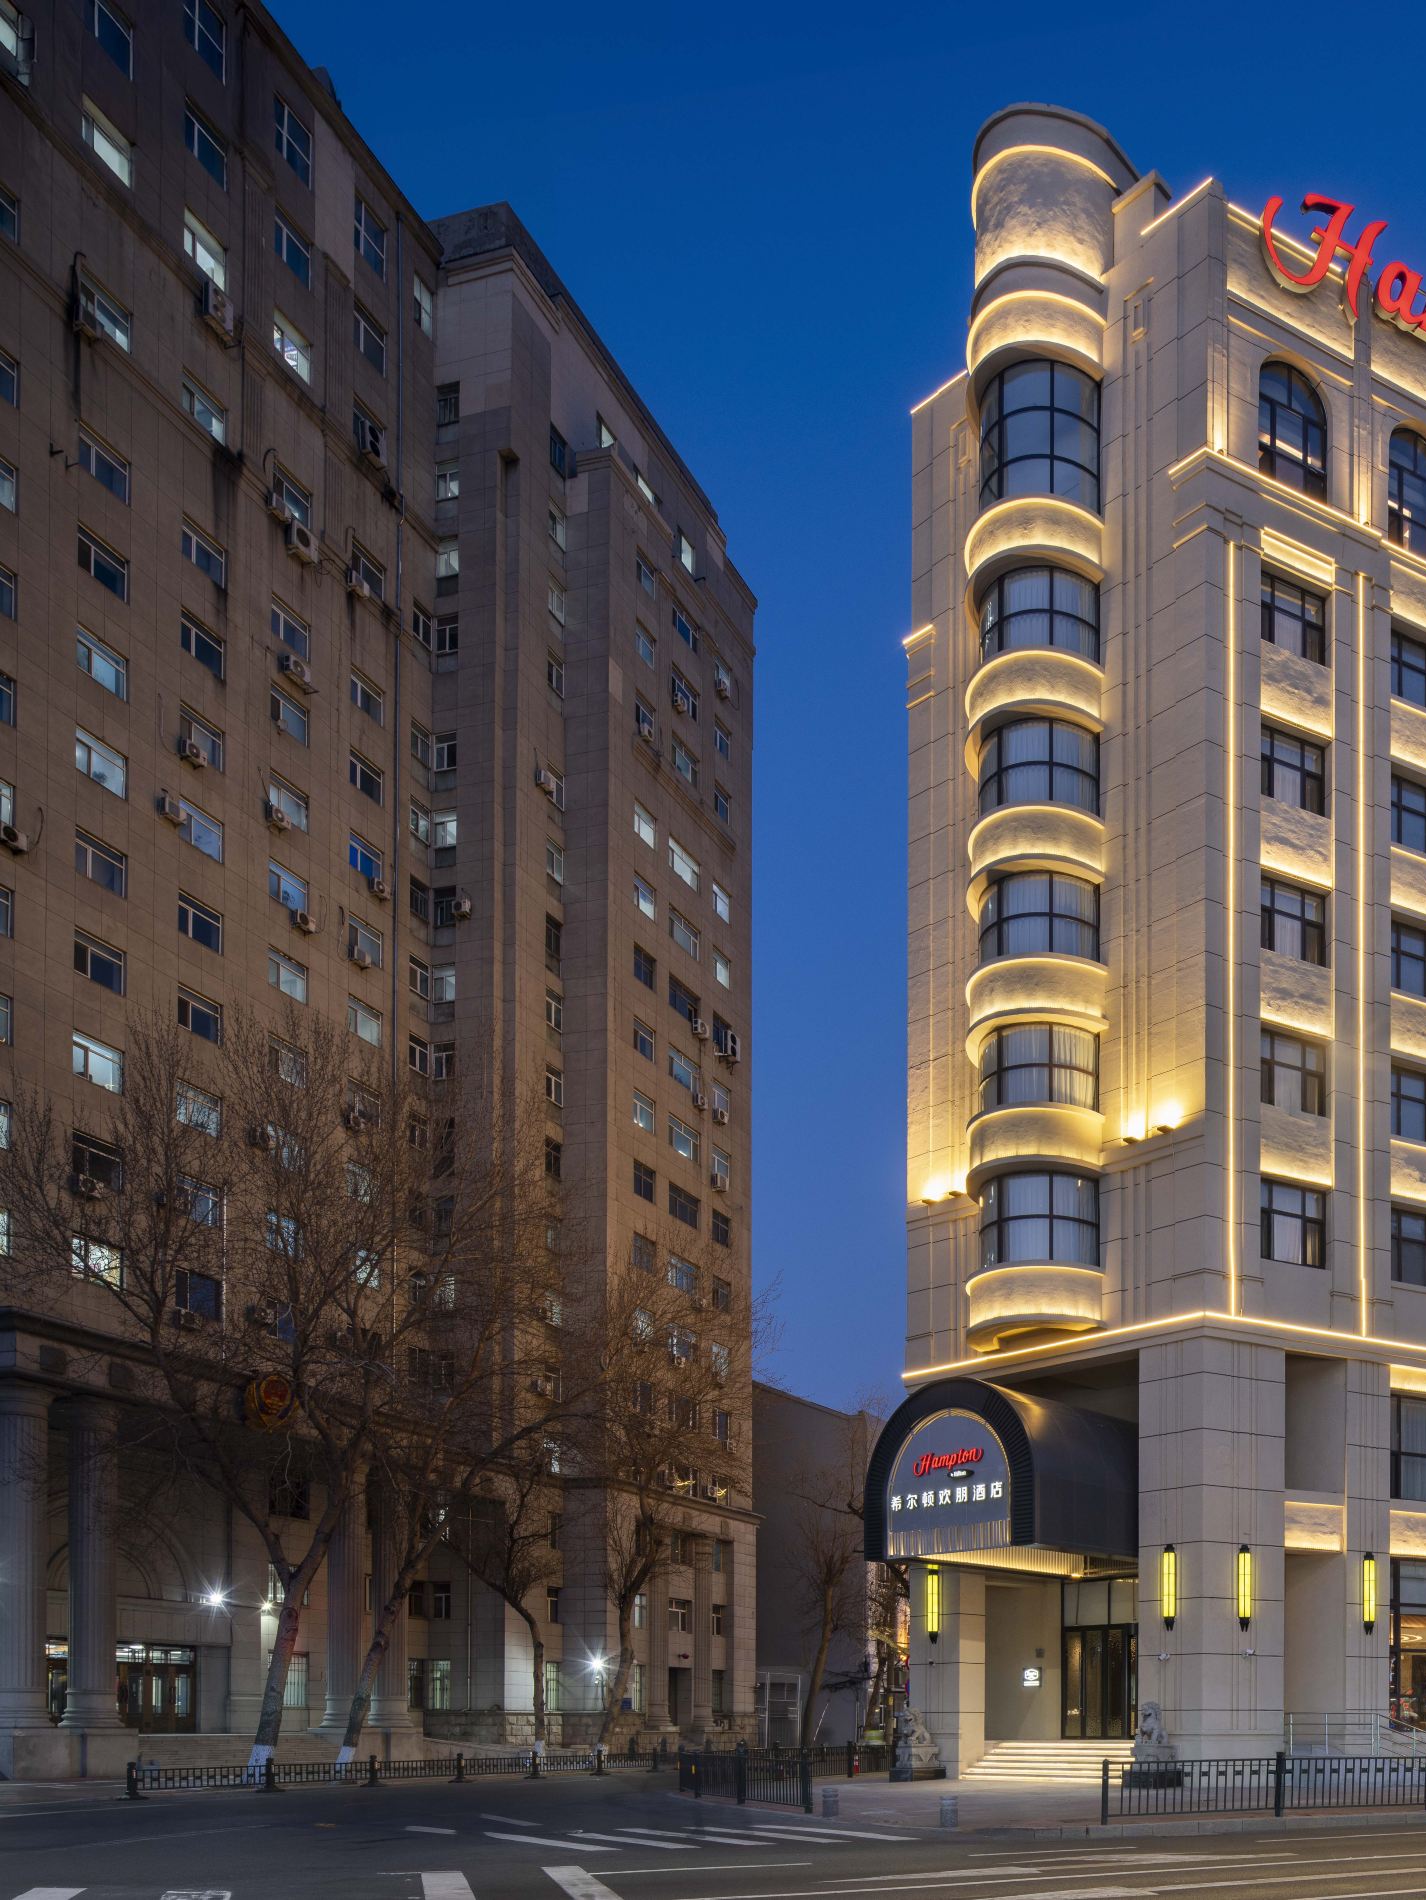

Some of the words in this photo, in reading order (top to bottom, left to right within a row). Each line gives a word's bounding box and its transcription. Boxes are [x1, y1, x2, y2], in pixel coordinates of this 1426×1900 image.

[913, 1448, 984, 1477] Hampton
[890, 1481, 1003, 1512] 希尔顿欢朋酒店
